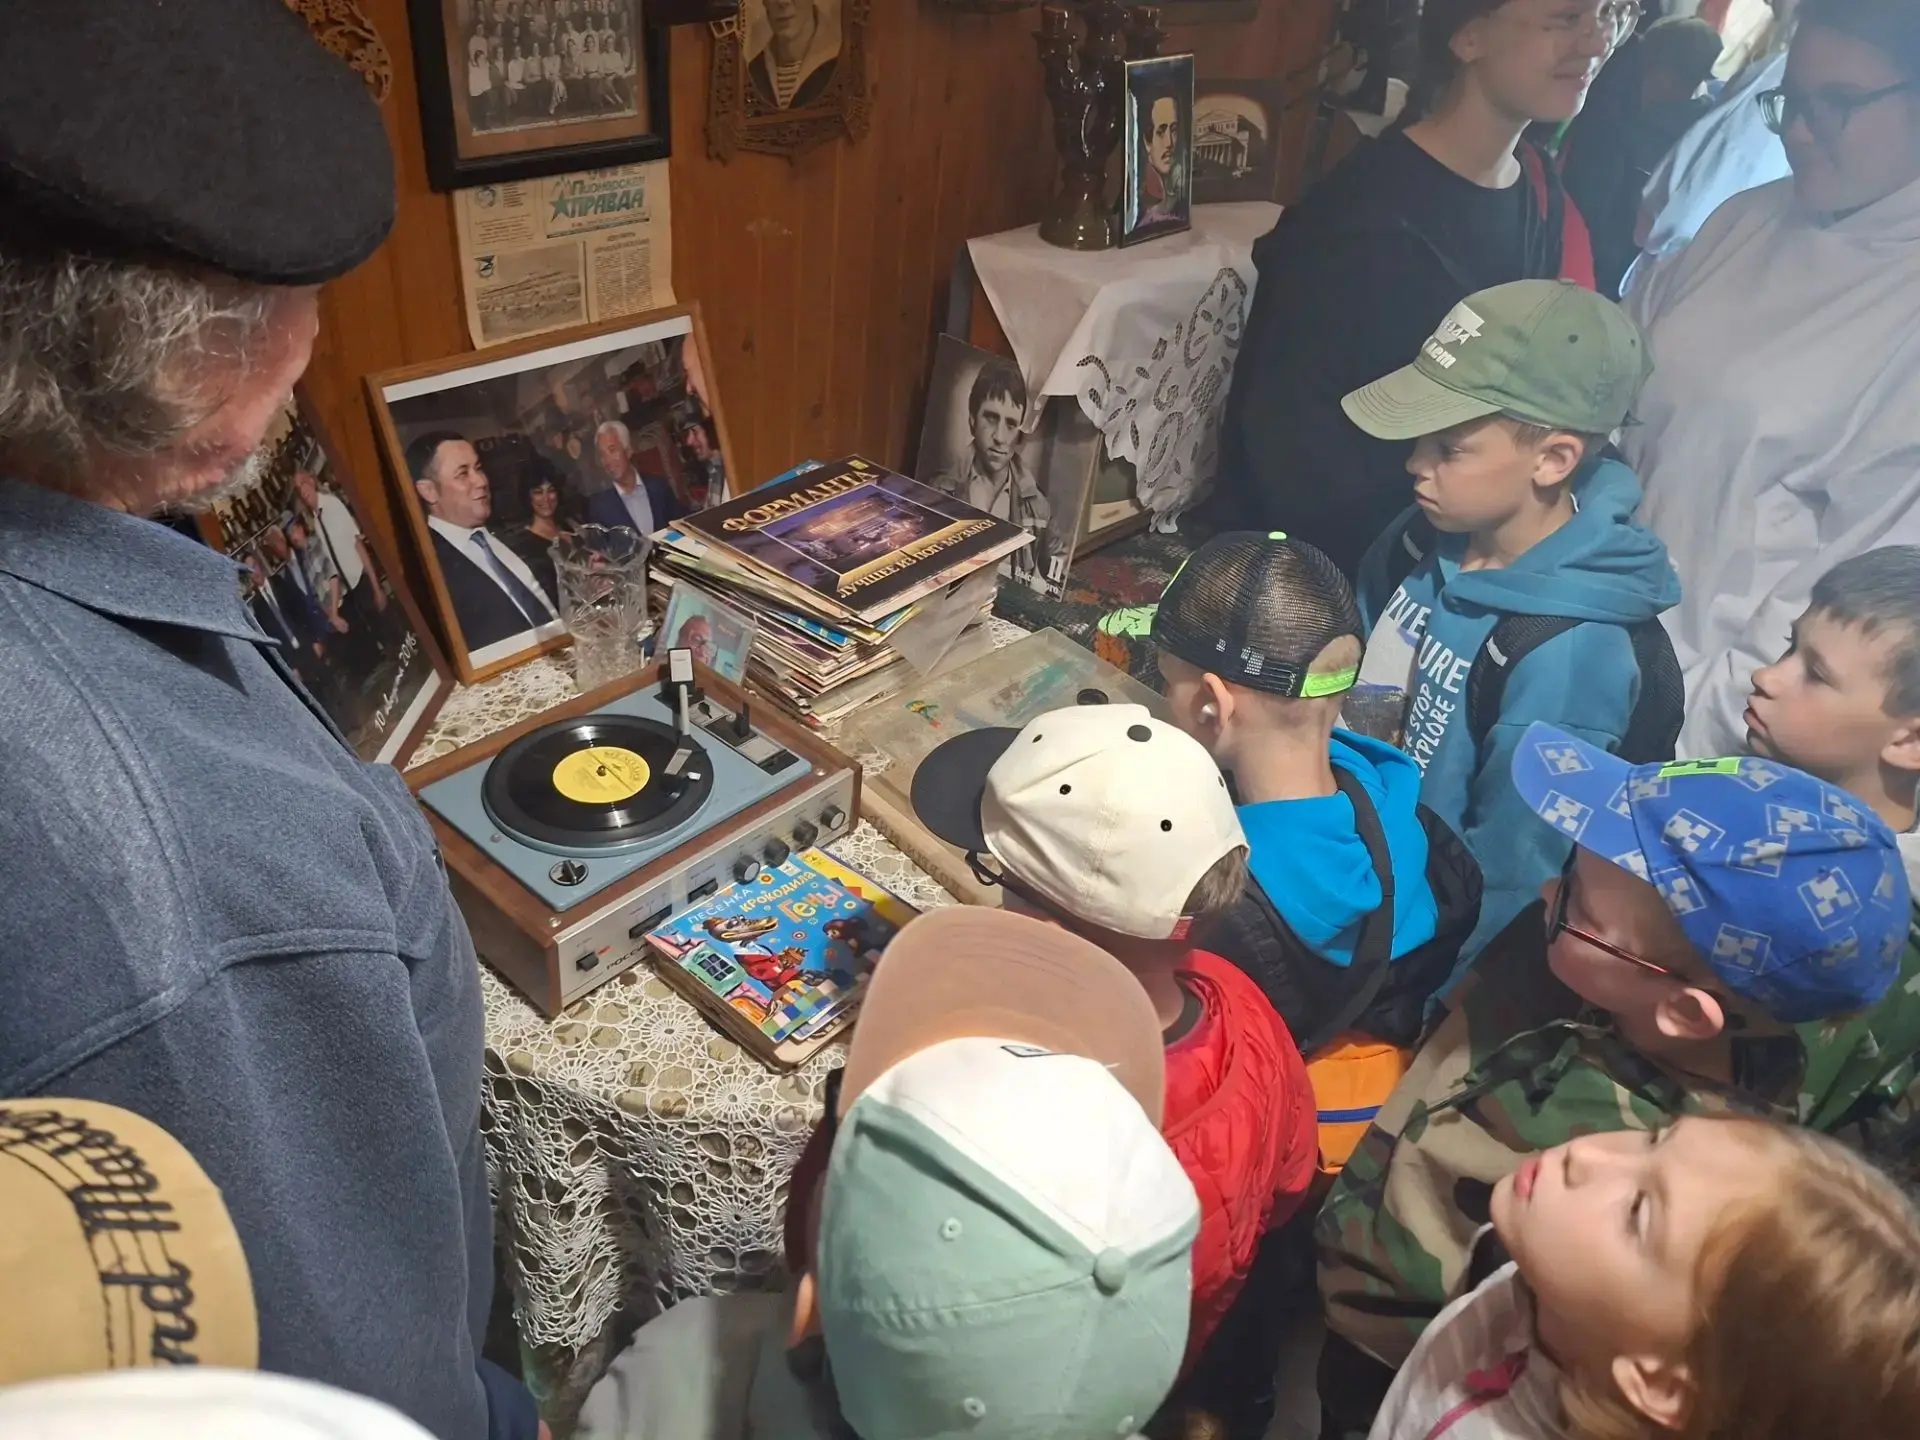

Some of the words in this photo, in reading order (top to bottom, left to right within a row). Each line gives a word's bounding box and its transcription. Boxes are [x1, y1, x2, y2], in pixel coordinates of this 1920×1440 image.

[567, 188, 644, 218] ПРАВДА
[722, 470, 879, 531] ФОРМАНТА
[840, 562, 900, 598] ЛУЧШЕЕ
[897, 554, 917, 570] ИЗ
[1410, 683, 1433, 730] STOP
[688, 888, 754, 924] ПЕСЕНКА
